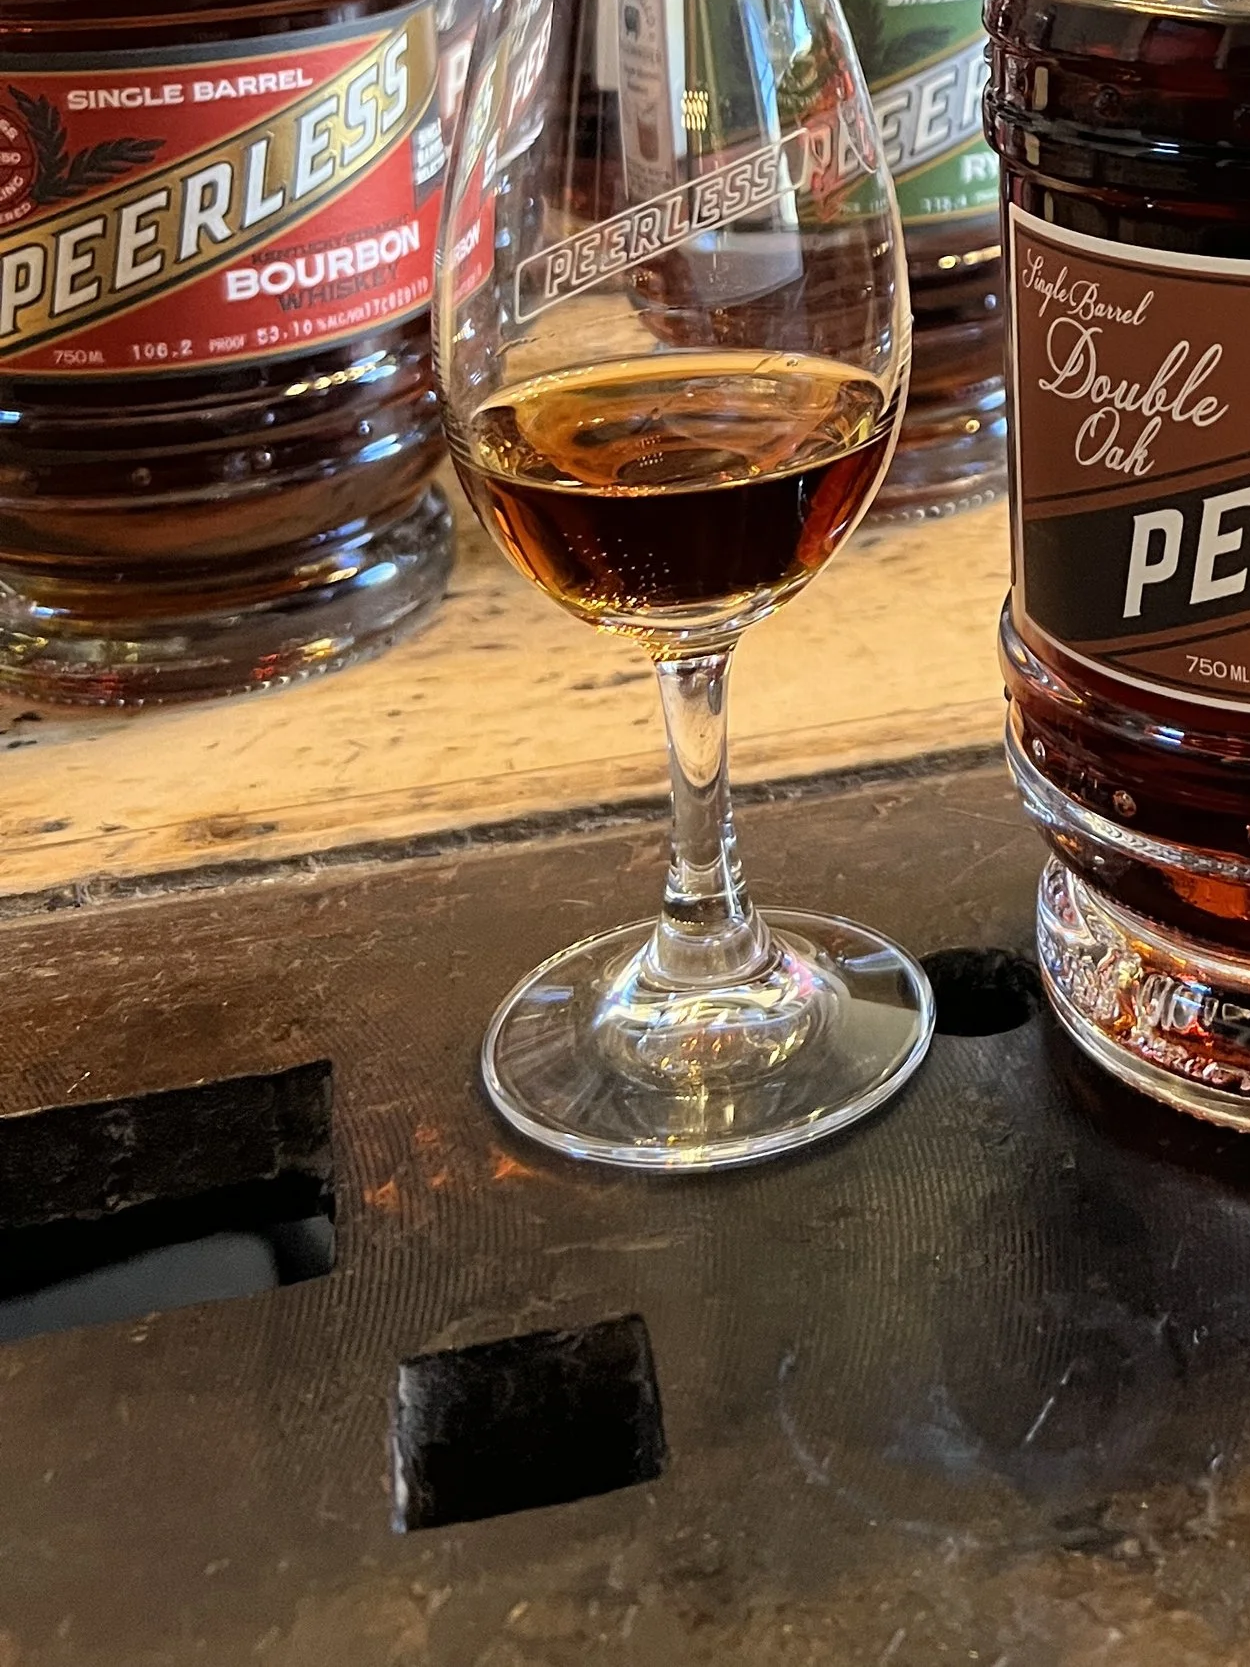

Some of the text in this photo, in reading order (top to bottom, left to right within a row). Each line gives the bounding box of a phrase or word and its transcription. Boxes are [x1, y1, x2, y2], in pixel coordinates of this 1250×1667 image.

[67, 68, 314, 111] SINGLE BARREL
[1, 32, 409, 334] PEERLESS
[225, 220, 421, 303] BOURBON
[545, 152, 777, 299] PEERLESS
[1022, 248, 1155, 326] Single Barrel
[132, 338, 193, 361] 106.2
[1038, 317, 1229, 427] Double
[1075, 406, 1163, 476] Oak
